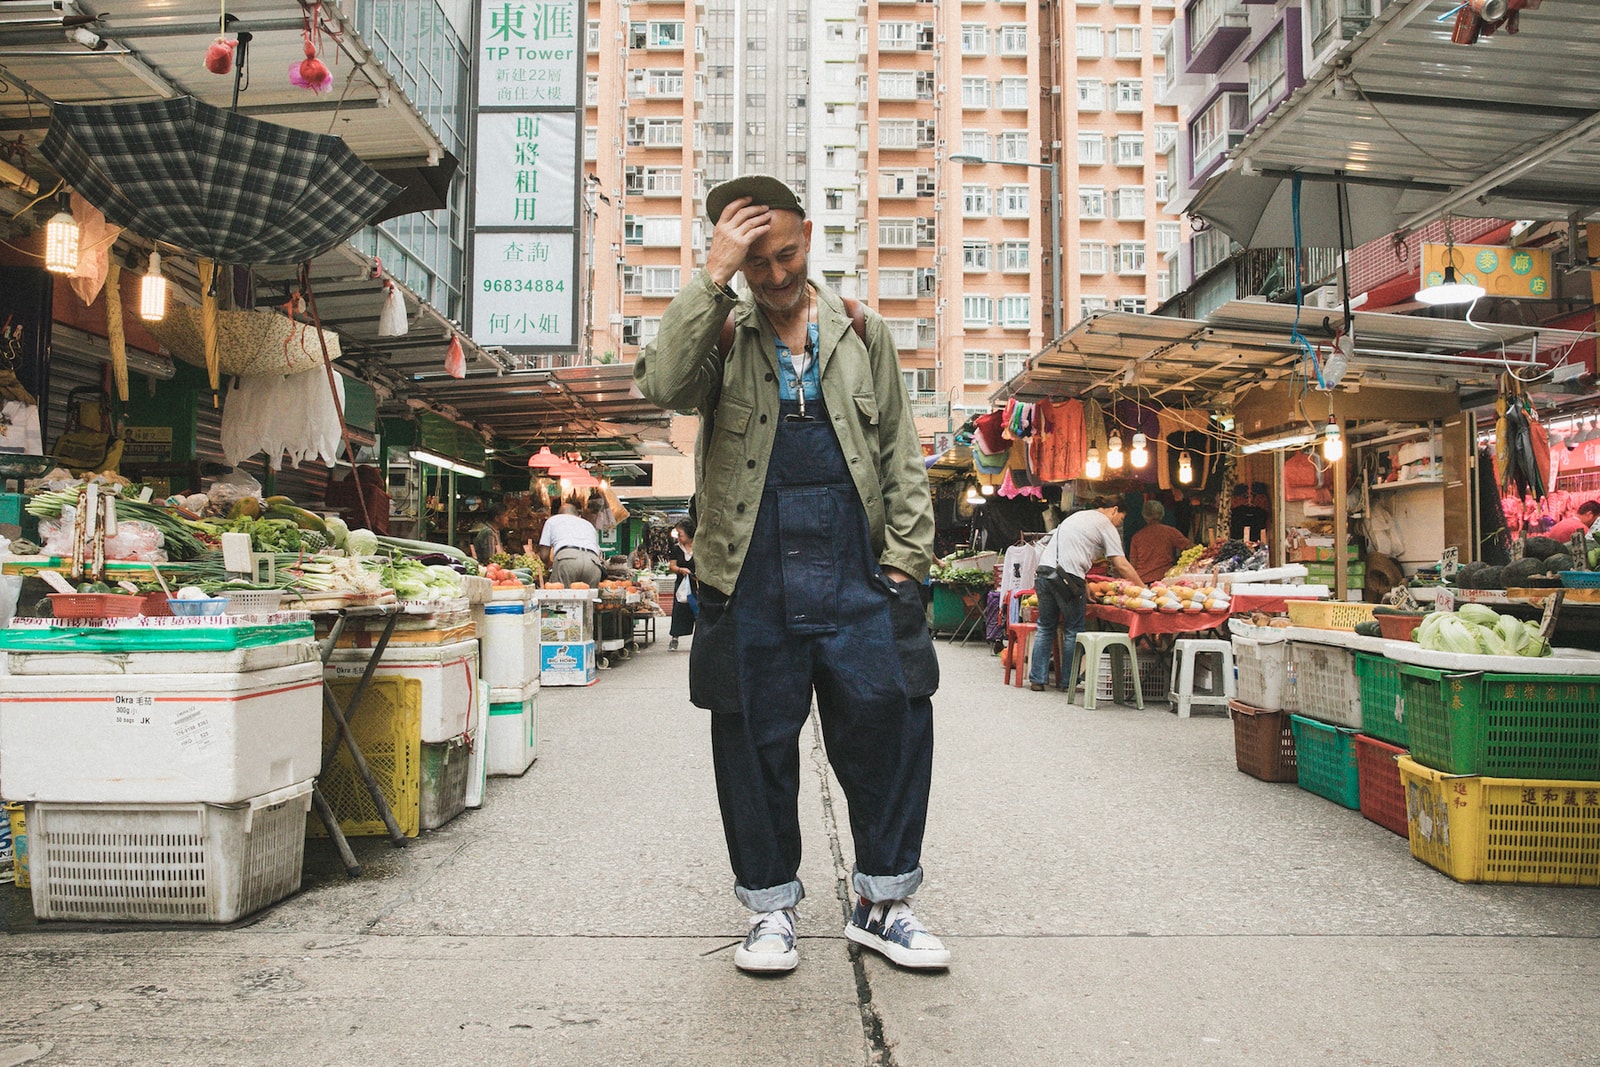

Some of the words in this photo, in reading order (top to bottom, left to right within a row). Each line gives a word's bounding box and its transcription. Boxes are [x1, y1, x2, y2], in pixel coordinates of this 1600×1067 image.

[486, 3, 574, 41] 東匯
[485, 47, 509, 60] TP
[515, 47, 573, 60] Tower
[497, 68, 562, 81] 新建22層
[497, 86, 562, 101] 商住大樓
[514, 116, 540, 221] 即將租用
[503, 241, 549, 262] 查詢
[483, 279, 565, 292] 96834884
[489, 313, 560, 334] 何小姐
[115, 695, 134, 704] Okra
[116, 706, 130, 715] 300g
[140, 717, 151, 725] JK
[1521, 788, 1599, 807] 進和蔬菜
